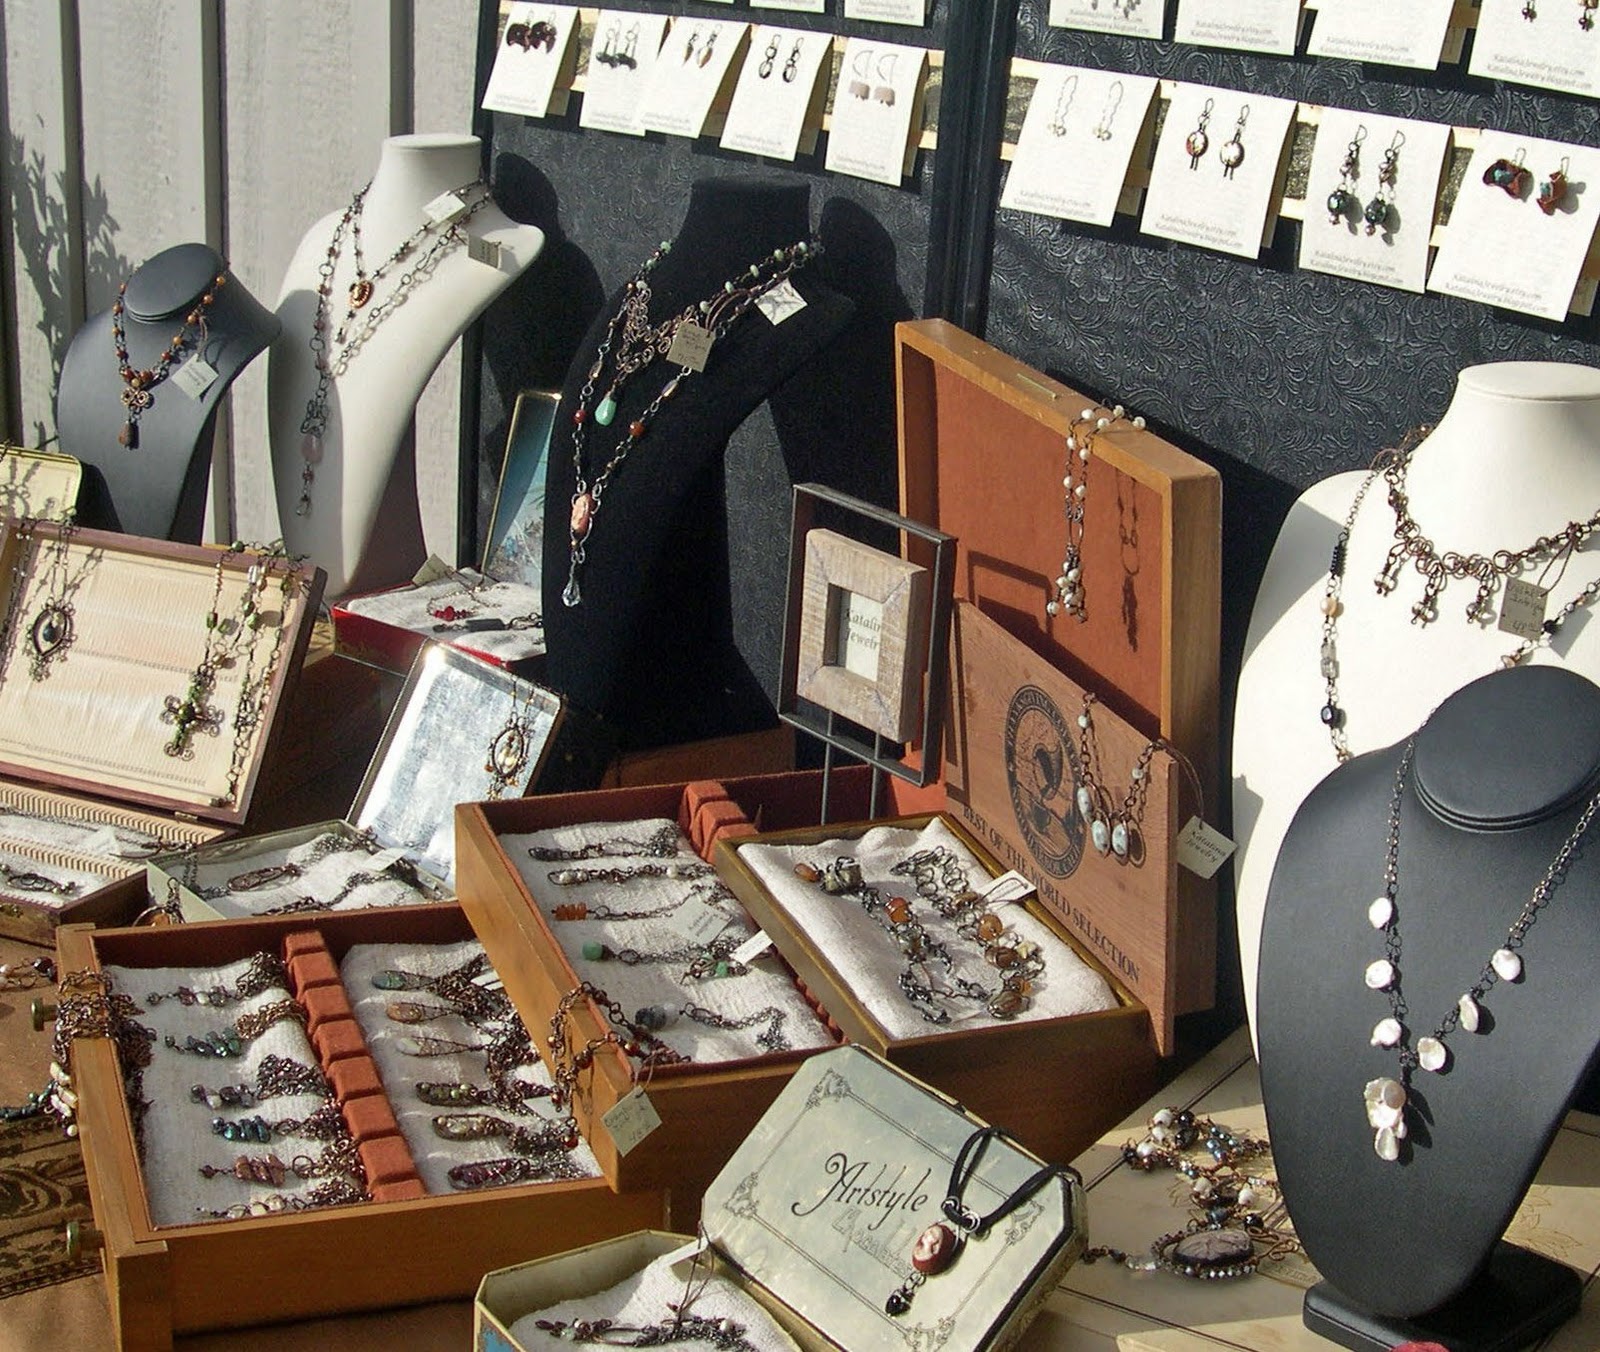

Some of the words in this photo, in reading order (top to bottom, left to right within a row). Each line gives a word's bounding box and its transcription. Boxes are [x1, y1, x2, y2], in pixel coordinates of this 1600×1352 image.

[963, 807, 988, 834] BEST
[989, 828, 1005, 847] OF
[1006, 843, 1028, 877] THE
[1029, 868, 1070, 916] WORLD
[1072, 908, 1140, 984] SELECTION
[791, 1153, 932, 1231] Artstyle
